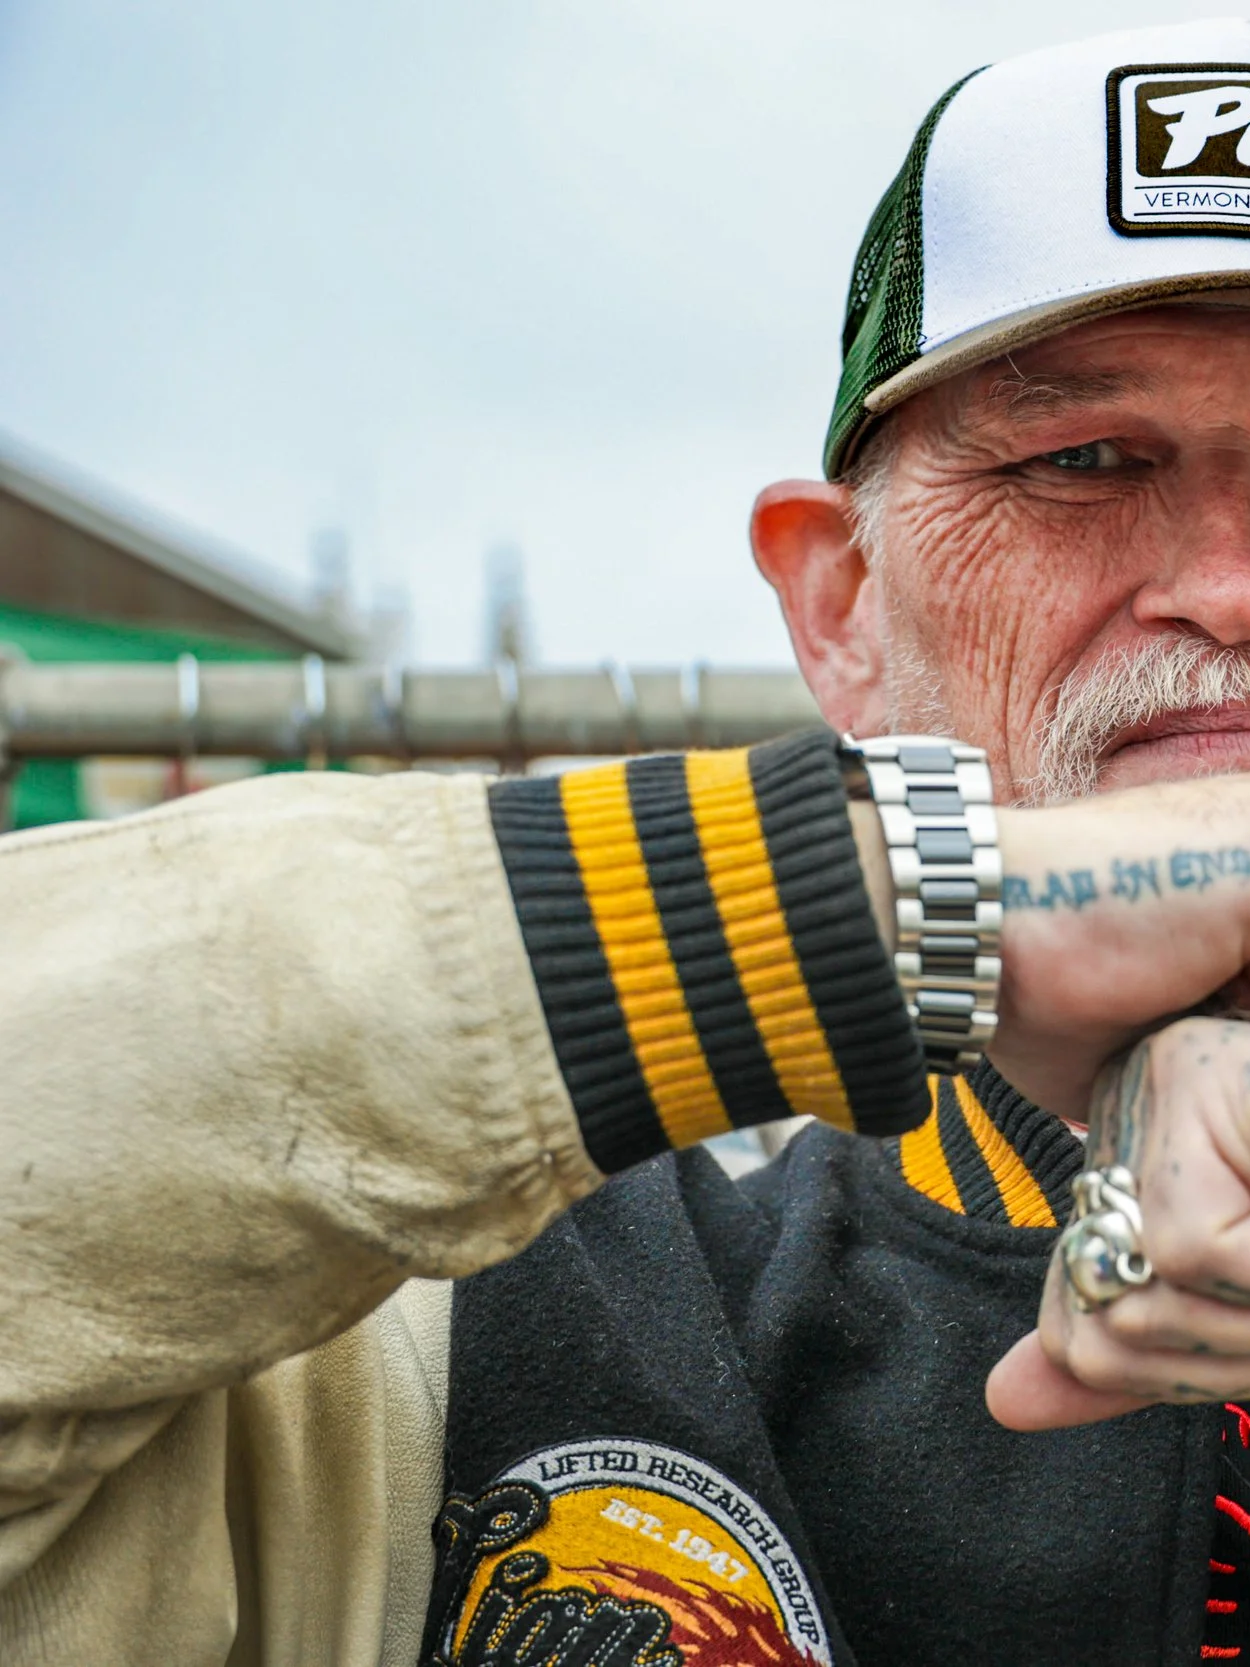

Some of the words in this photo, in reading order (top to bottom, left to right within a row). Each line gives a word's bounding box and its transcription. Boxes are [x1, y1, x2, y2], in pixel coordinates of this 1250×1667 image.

[1110, 856, 1164, 905] IN
[538, 1450, 638, 1482] LIFTED
[646, 1456, 781, 1563] RESEARCH
[771, 1557, 821, 1645] GROUP
[600, 1498, 665, 1543] EST.
[669, 1528, 750, 1585] 1947
